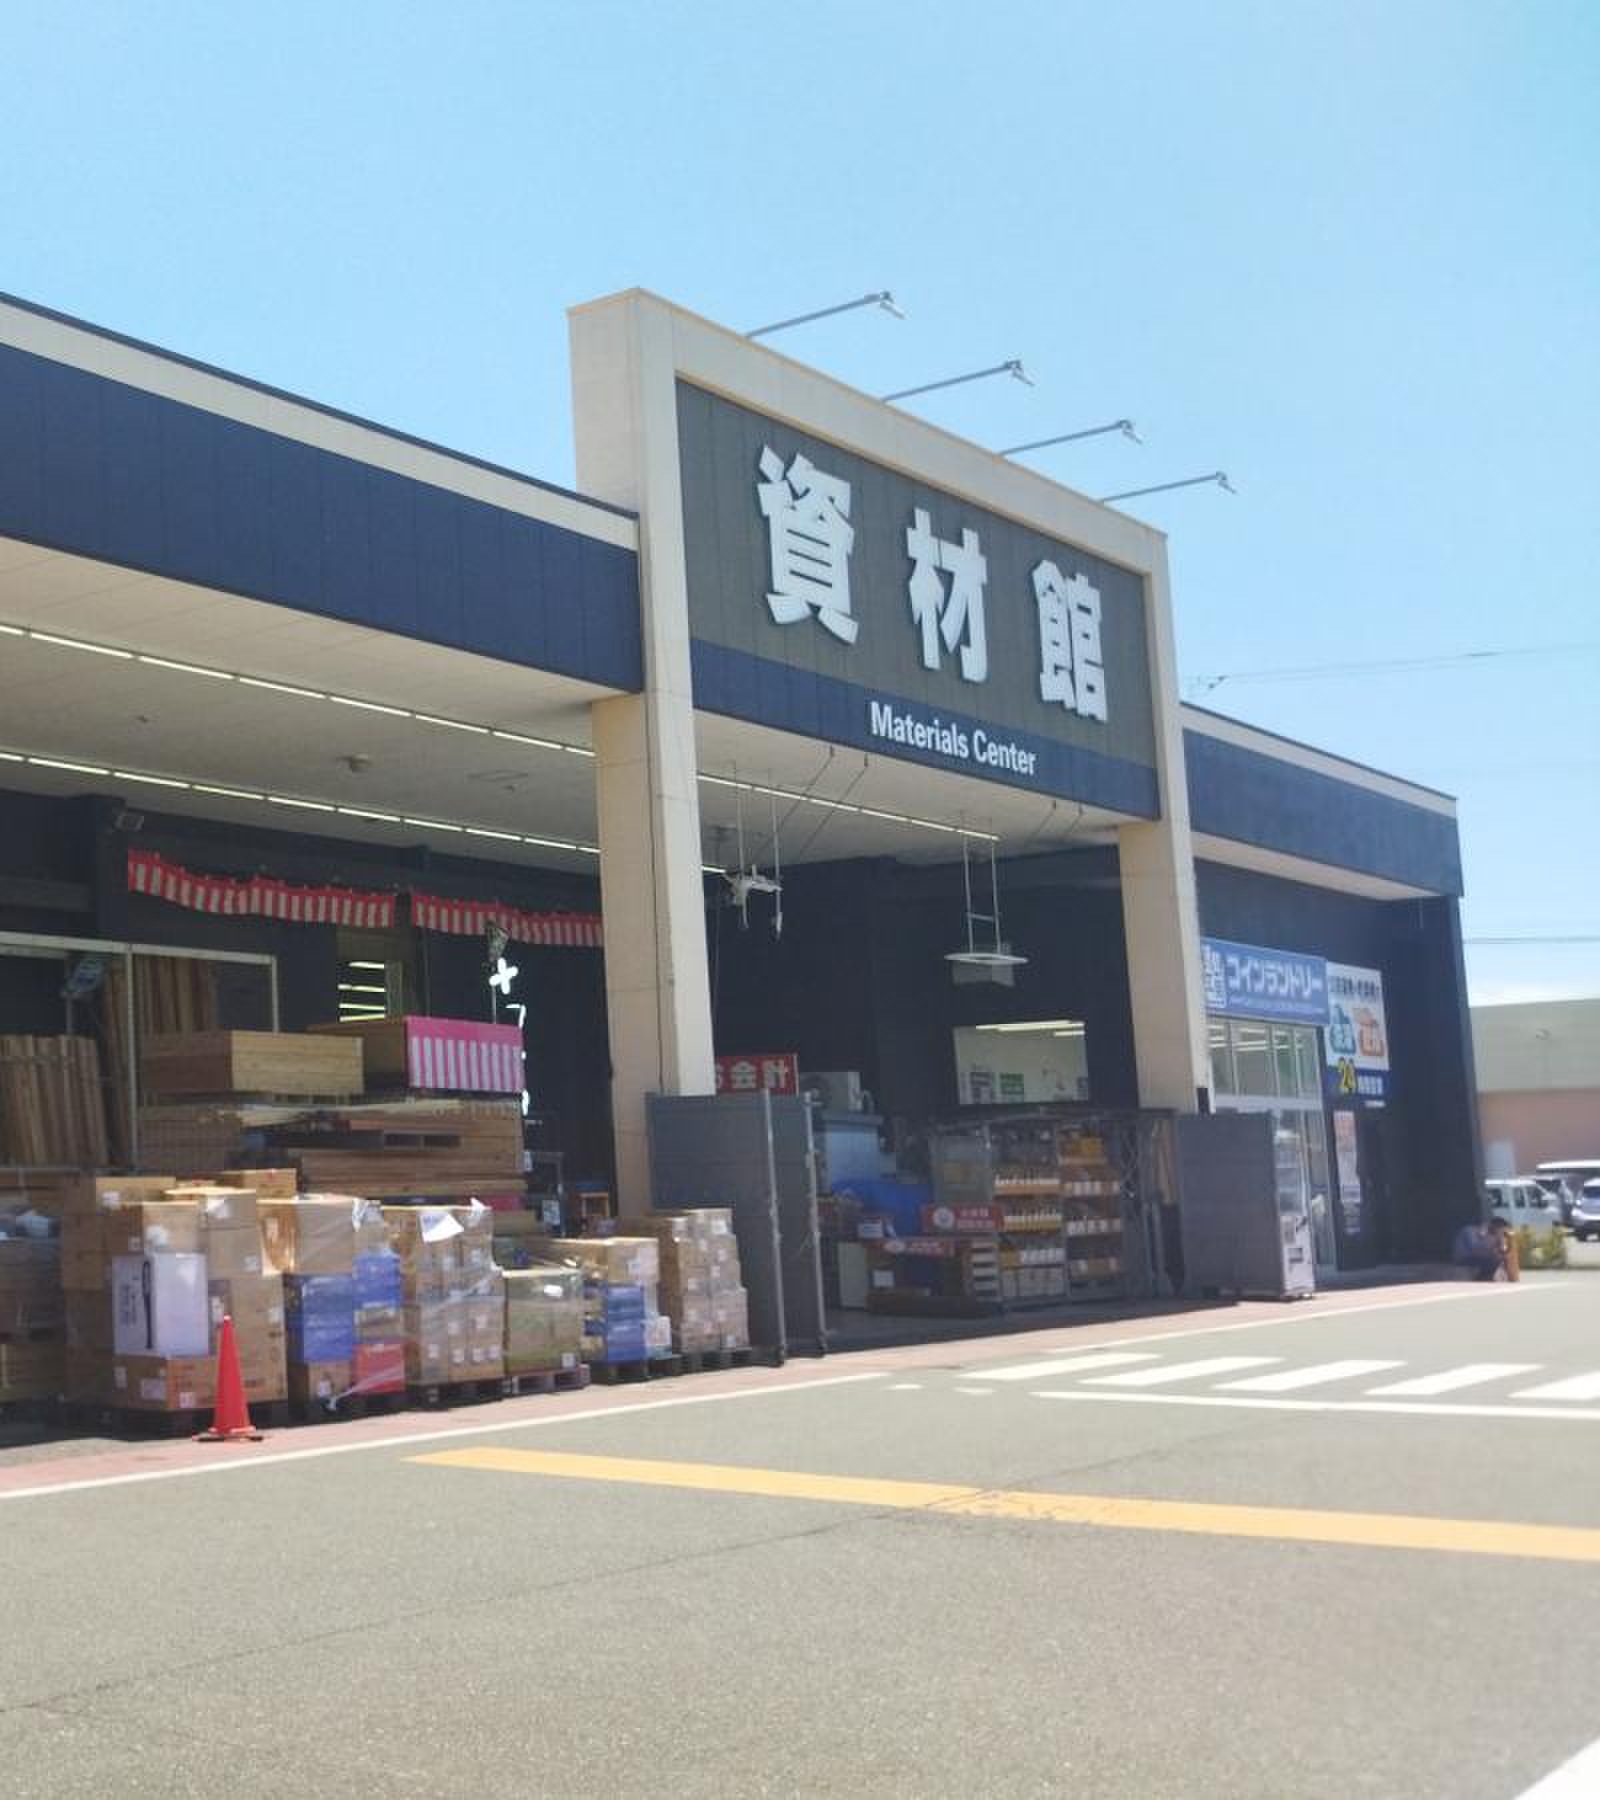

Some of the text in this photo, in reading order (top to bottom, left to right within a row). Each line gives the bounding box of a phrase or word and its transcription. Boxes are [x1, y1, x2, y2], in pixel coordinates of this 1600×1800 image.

[757, 445, 1109, 723] 資材館
[870, 701, 1037, 776] Materials Center
